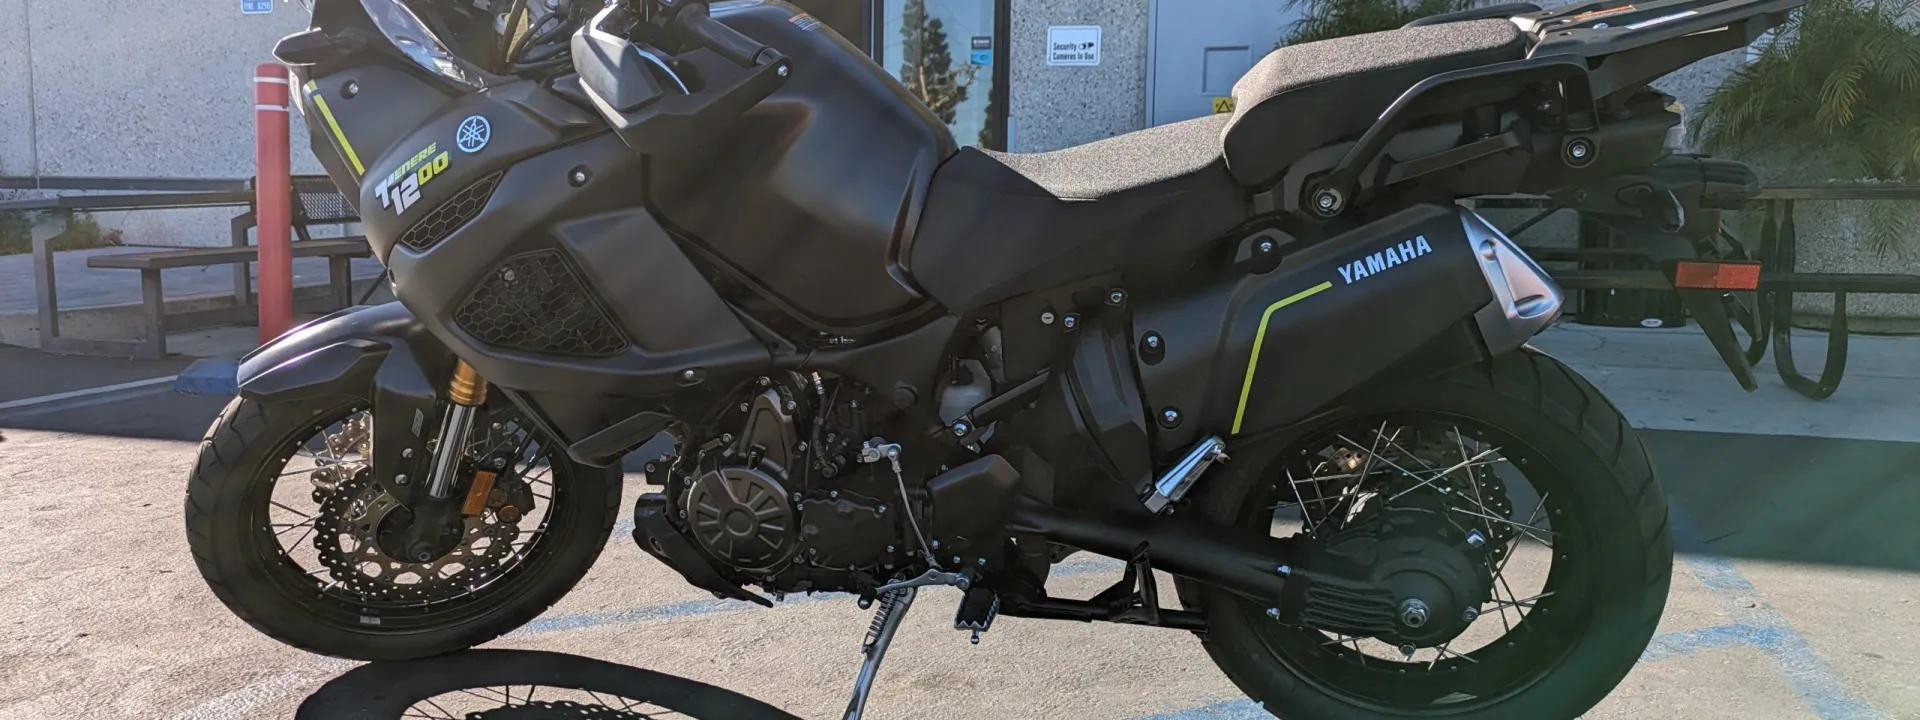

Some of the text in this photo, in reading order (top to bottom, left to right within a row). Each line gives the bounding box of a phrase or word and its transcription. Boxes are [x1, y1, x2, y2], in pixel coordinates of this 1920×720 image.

[1053, 42, 1077, 52] Security
[1053, 52, 1076, 60] Cameras
[1084, 52, 1094, 60] Use
[391, 151, 449, 216] 1200
[1338, 235, 1432, 284] YAMAHA
